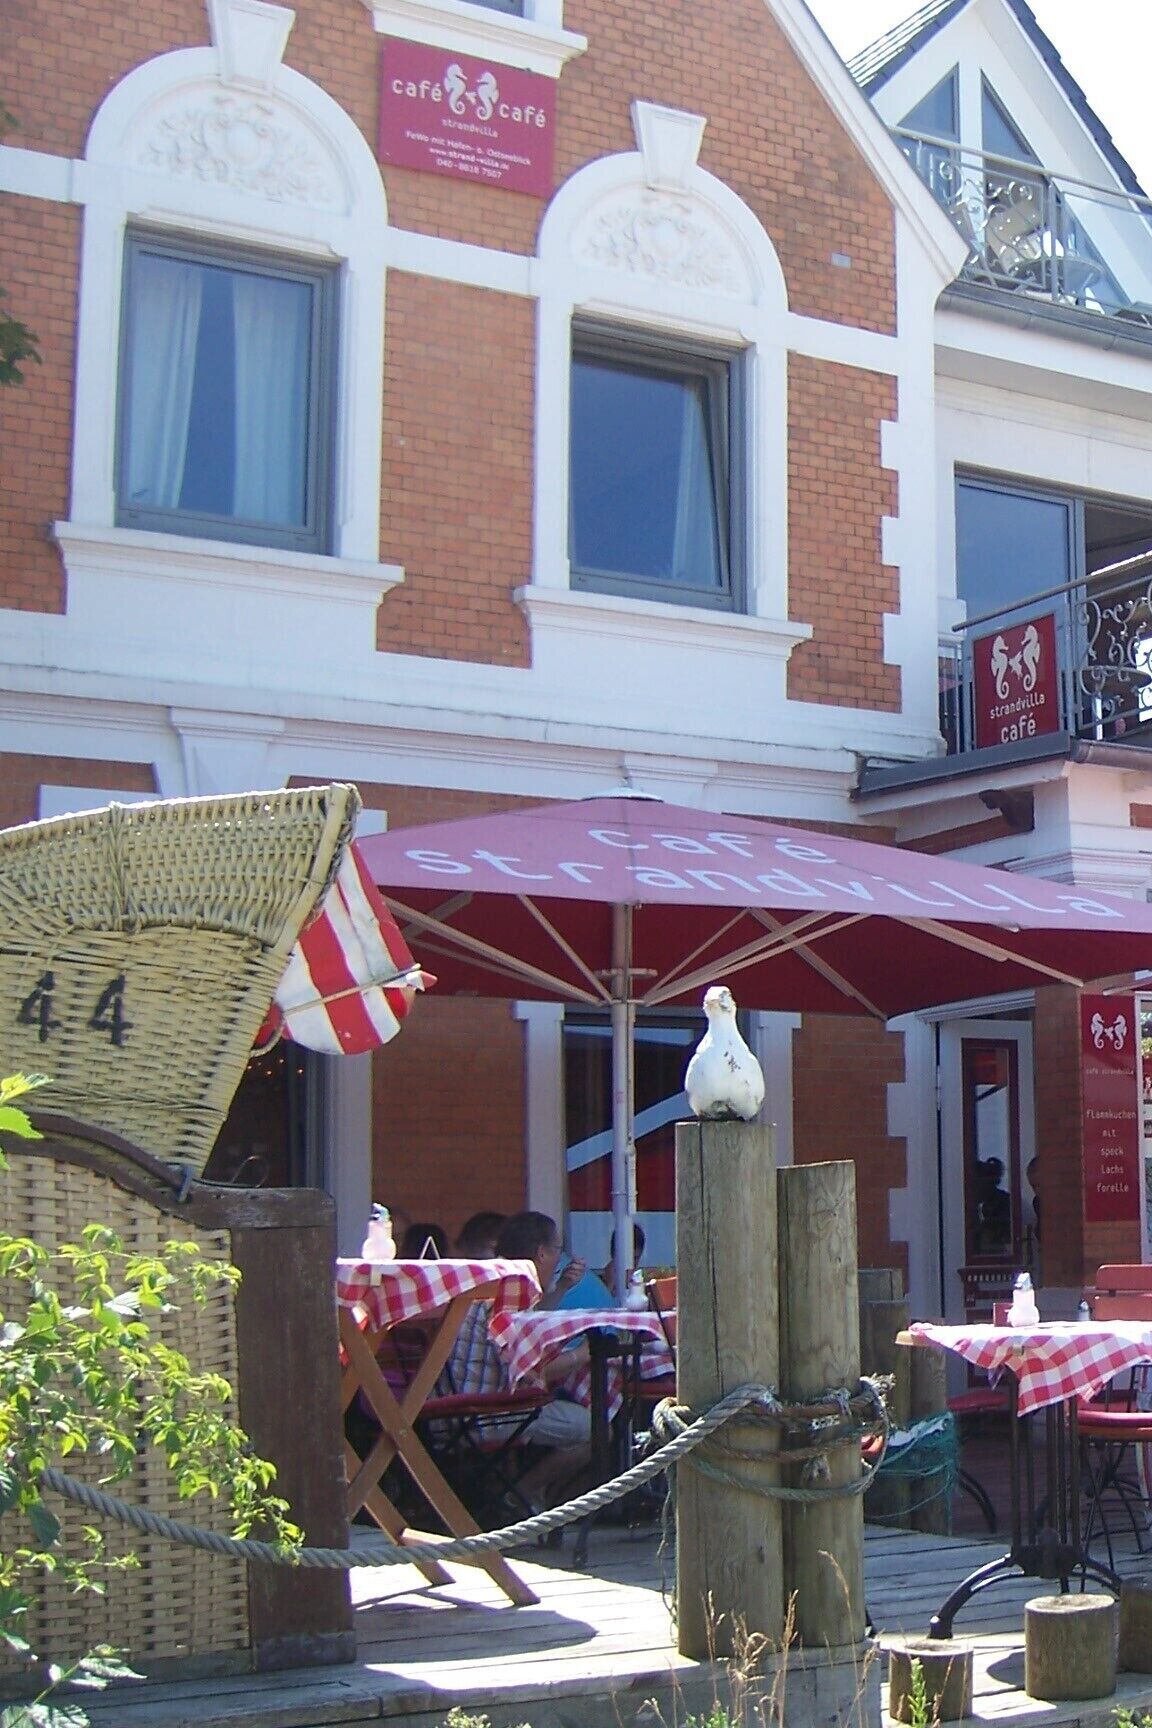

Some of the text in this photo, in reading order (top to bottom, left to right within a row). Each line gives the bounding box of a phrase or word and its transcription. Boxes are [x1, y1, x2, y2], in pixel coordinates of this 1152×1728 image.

[391, 78, 443, 102] café
[441, 118, 499, 139] strandvilla
[499, 103, 547, 128] café
[990, 692, 1046, 720] strandvilla
[1001, 712, 1037, 743] café
[588, 826, 838, 866] café
[404, 848, 1126, 919] strandvilla
[1097, 1181, 1129, 1193] forelle
